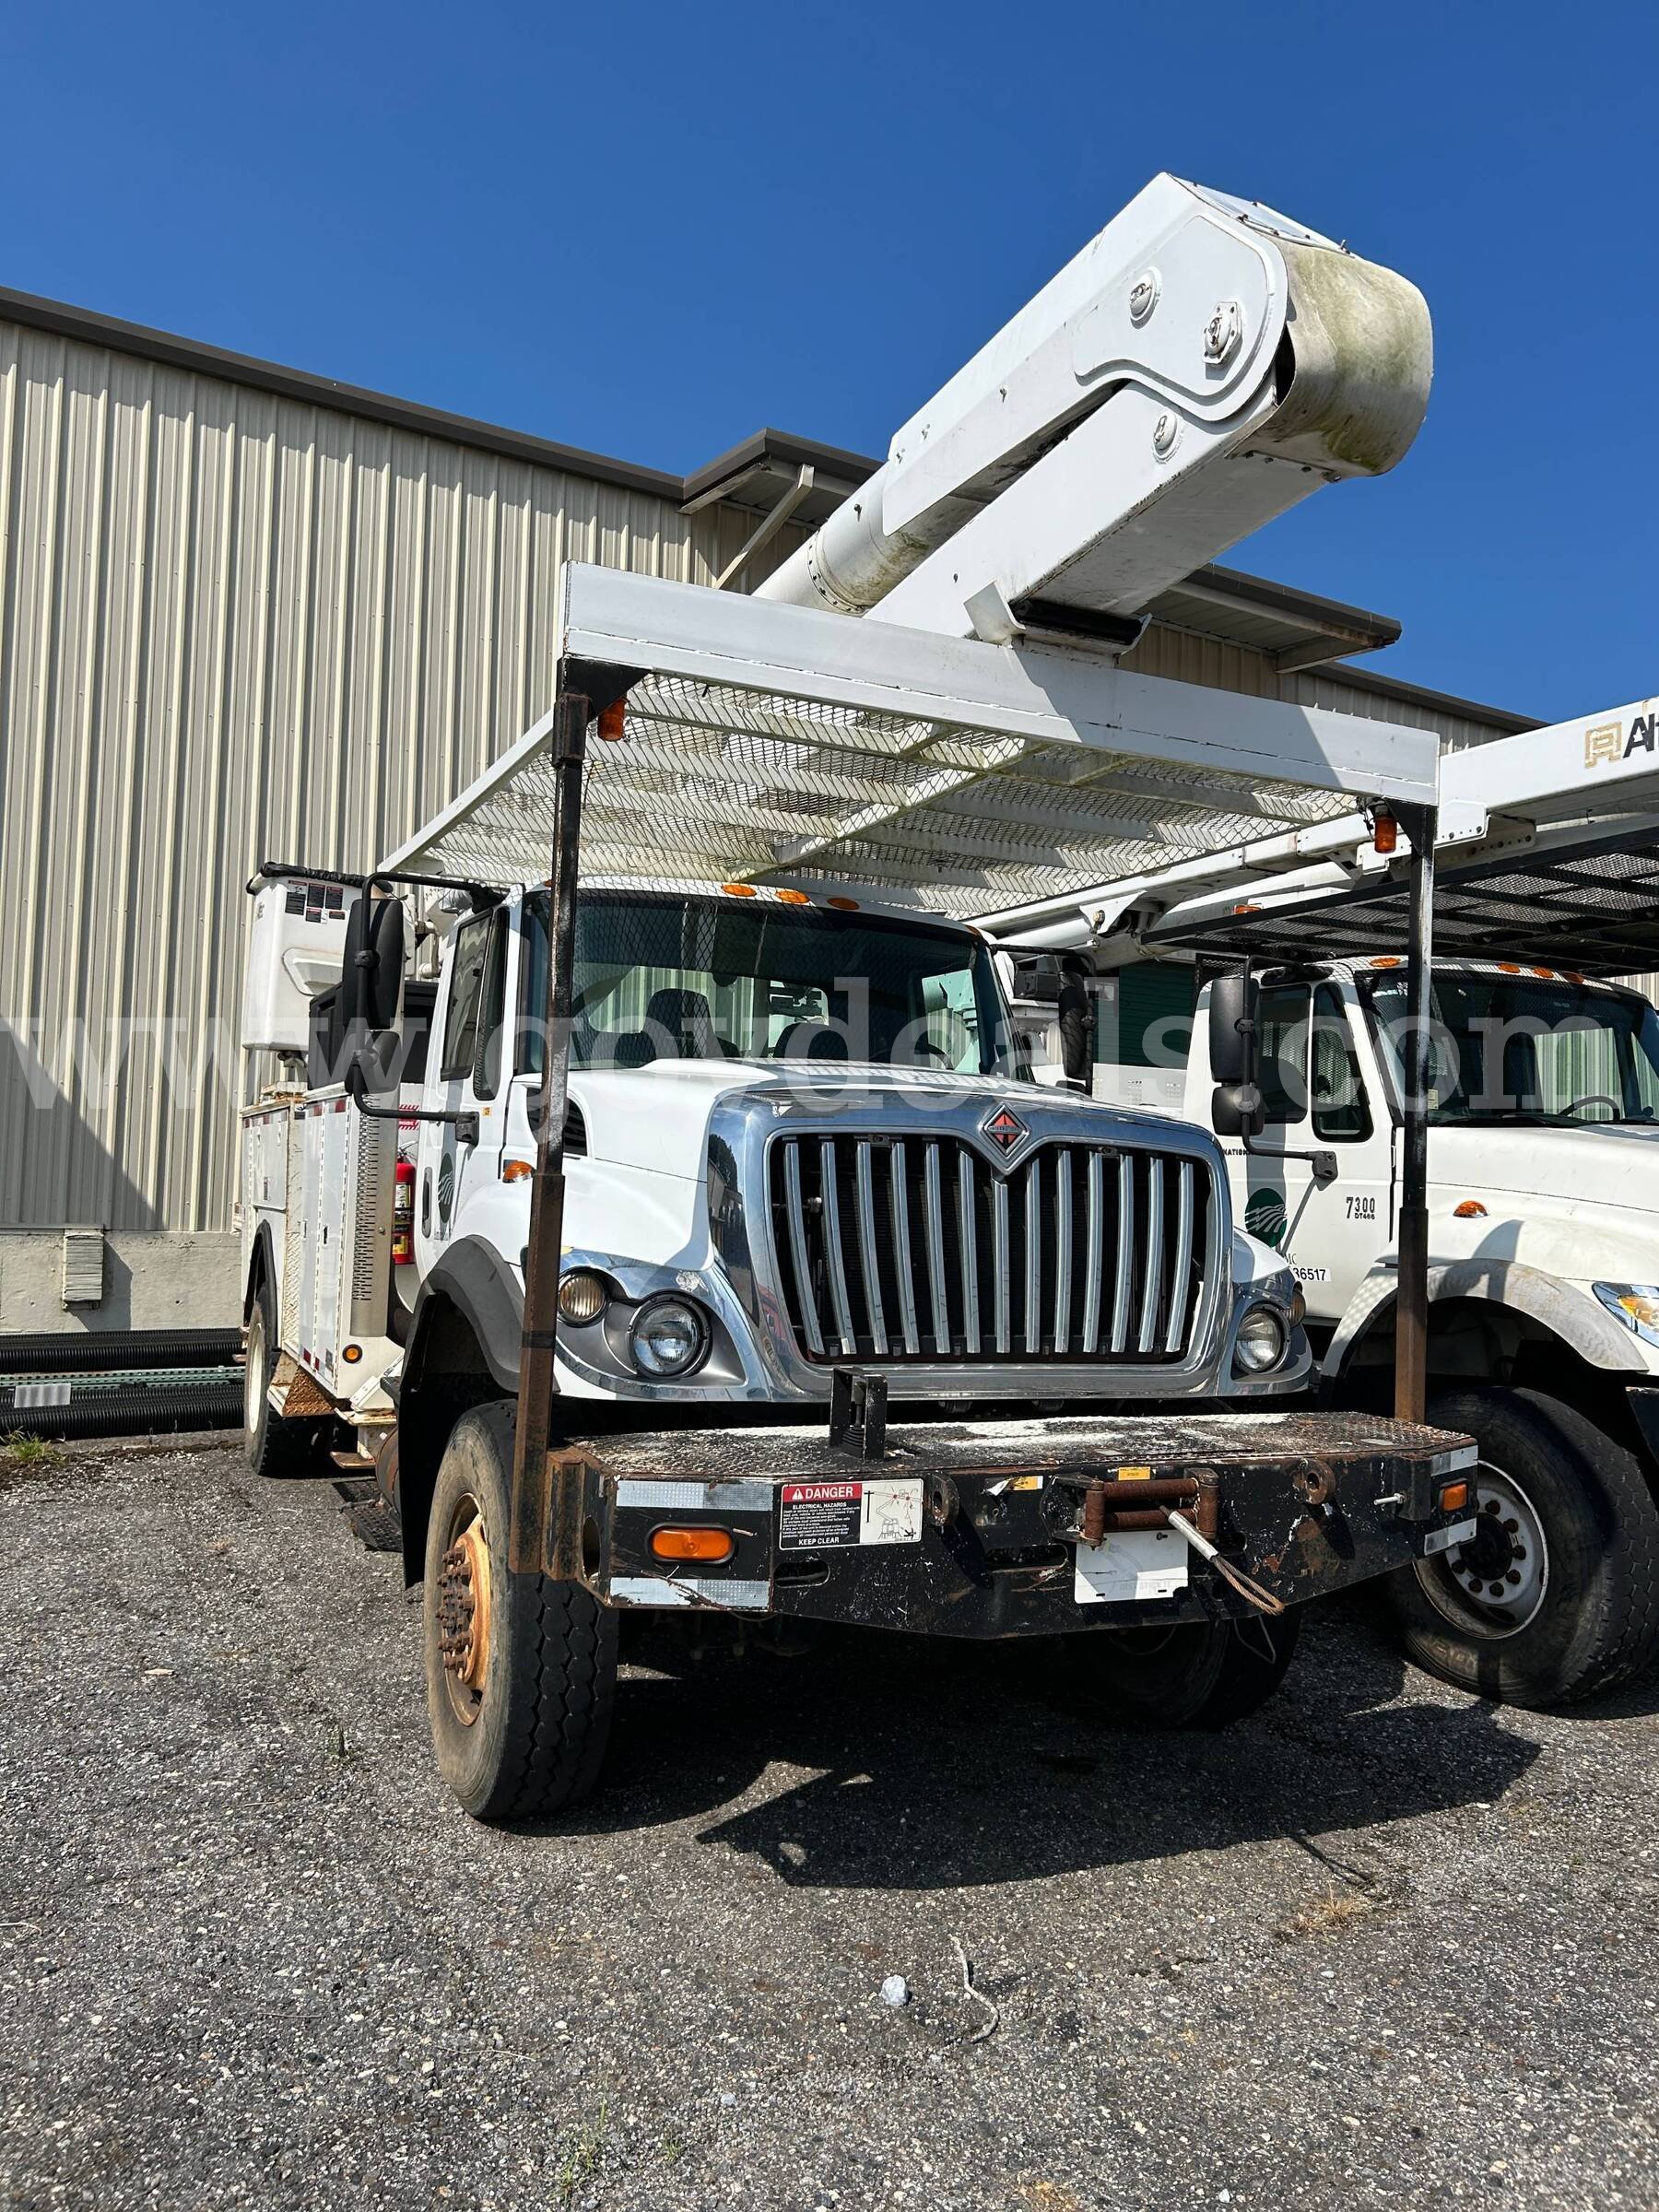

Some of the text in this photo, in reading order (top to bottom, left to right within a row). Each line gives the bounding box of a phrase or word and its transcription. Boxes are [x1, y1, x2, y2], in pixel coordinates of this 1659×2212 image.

[1346, 1196, 1375, 1219] 7300
[805, 1486, 853, 1500] DANGER
[817, 1536, 840, 1545] CLEAR
